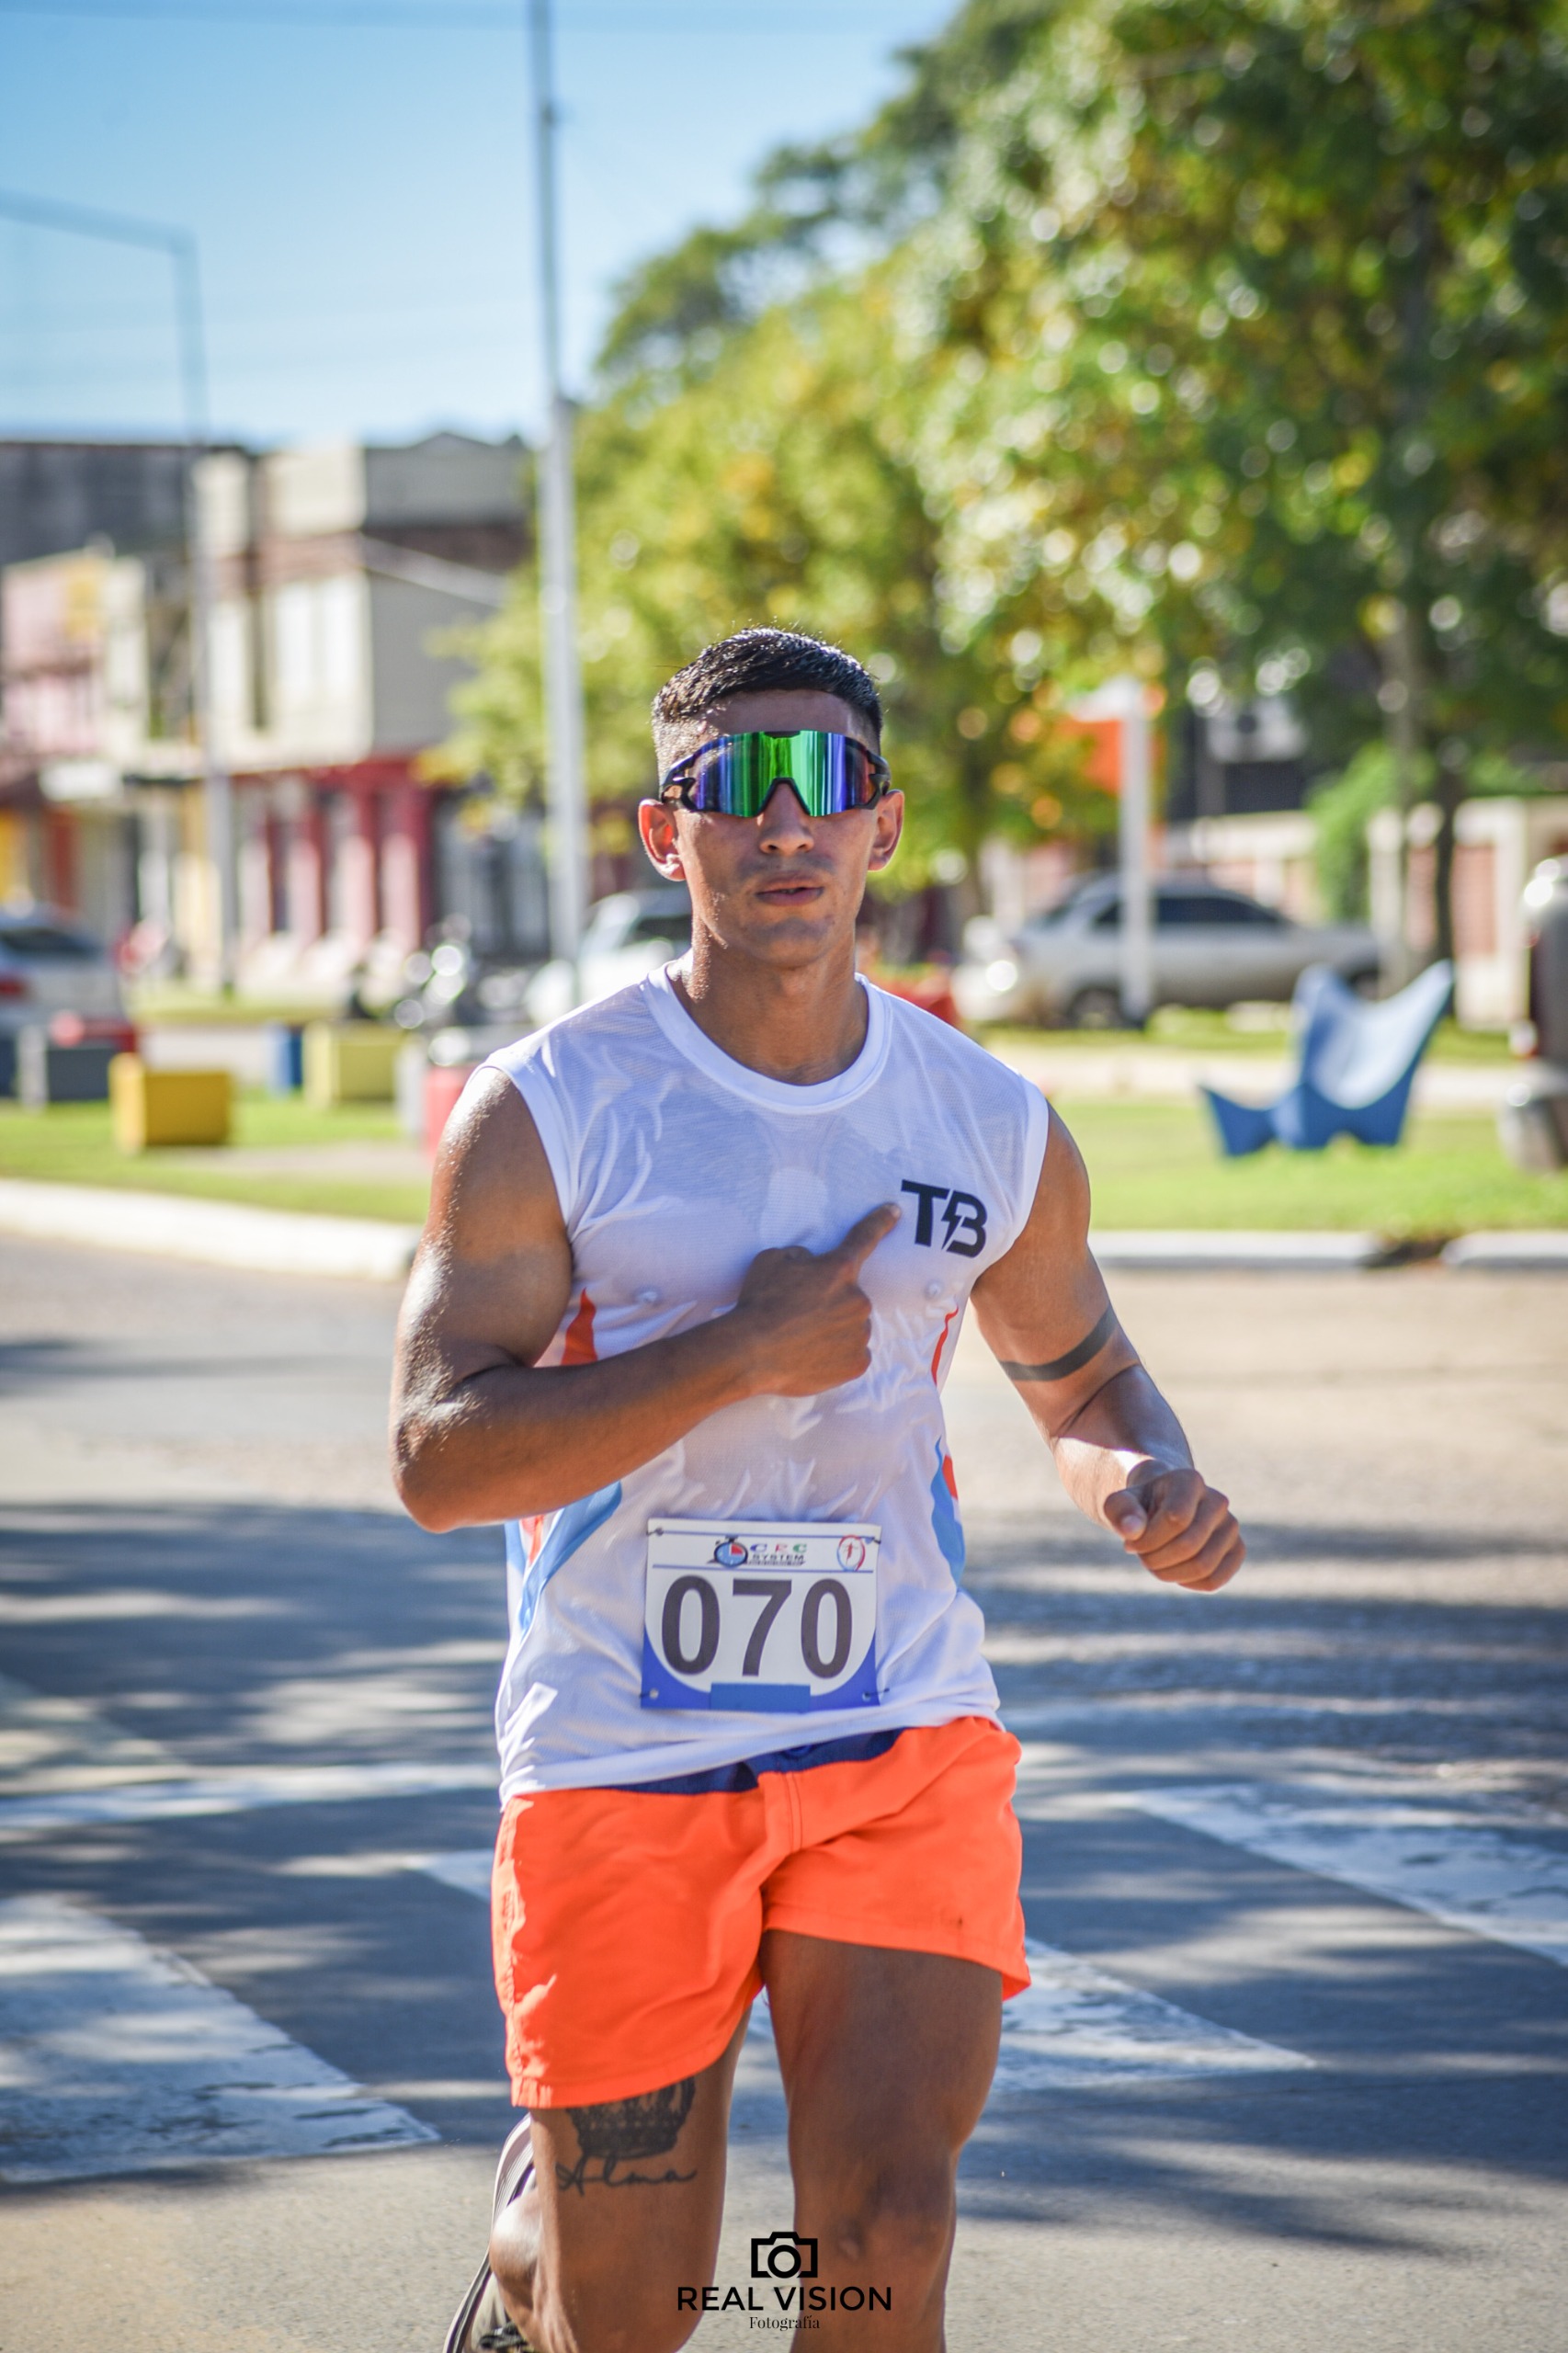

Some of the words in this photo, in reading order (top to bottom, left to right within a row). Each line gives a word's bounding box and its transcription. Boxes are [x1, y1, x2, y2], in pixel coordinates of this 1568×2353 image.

[901, 1179, 987, 1258] TB
[752, 1553, 804, 1562] SYSTEM
[662, 1574, 852, 1679] 070
